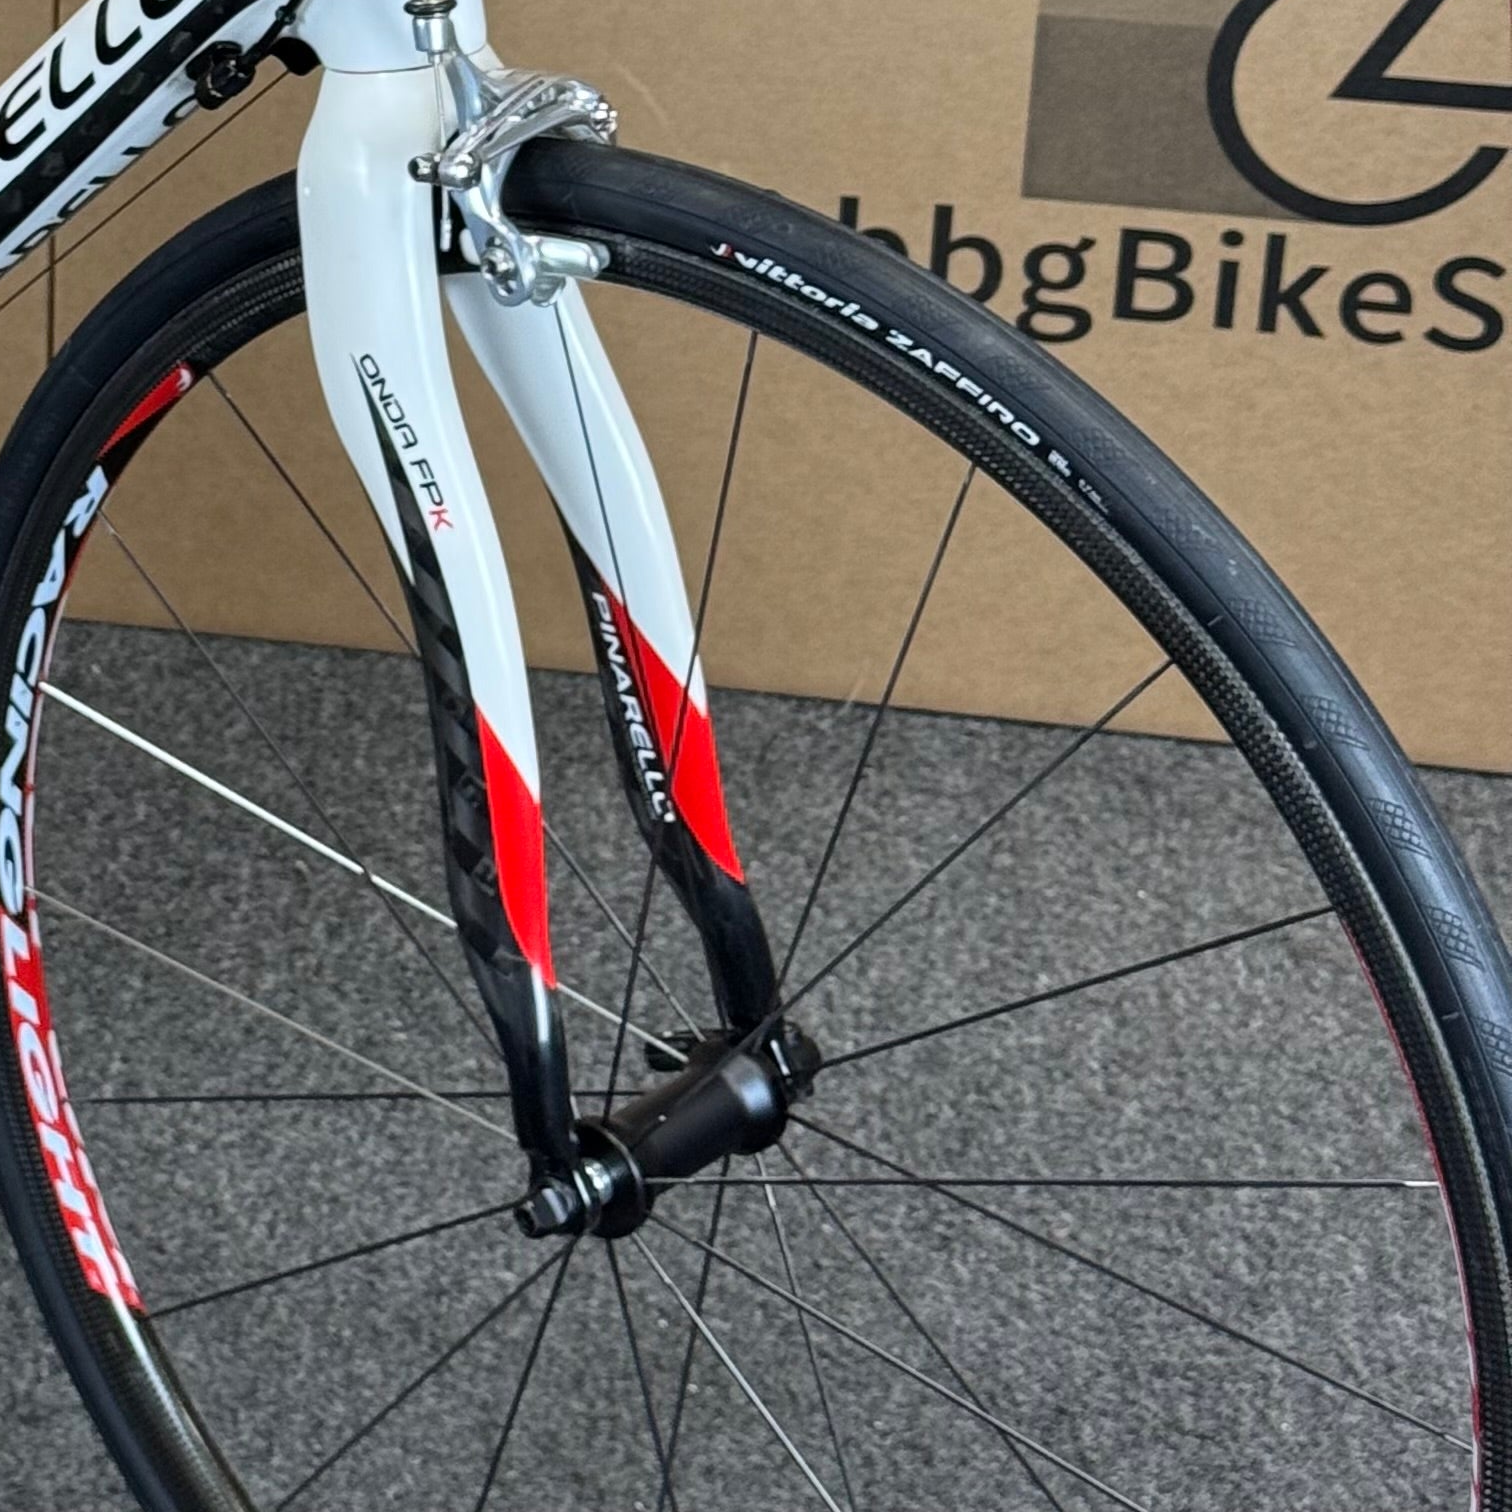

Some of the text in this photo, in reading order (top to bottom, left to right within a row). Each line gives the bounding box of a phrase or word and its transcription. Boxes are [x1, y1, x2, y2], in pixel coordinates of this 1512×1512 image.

[359, 353, 454, 531] ONDA FPK
[885, 329, 1040, 446] ZAFFIRO
[0, 913, 119, 1295] LIGHT
